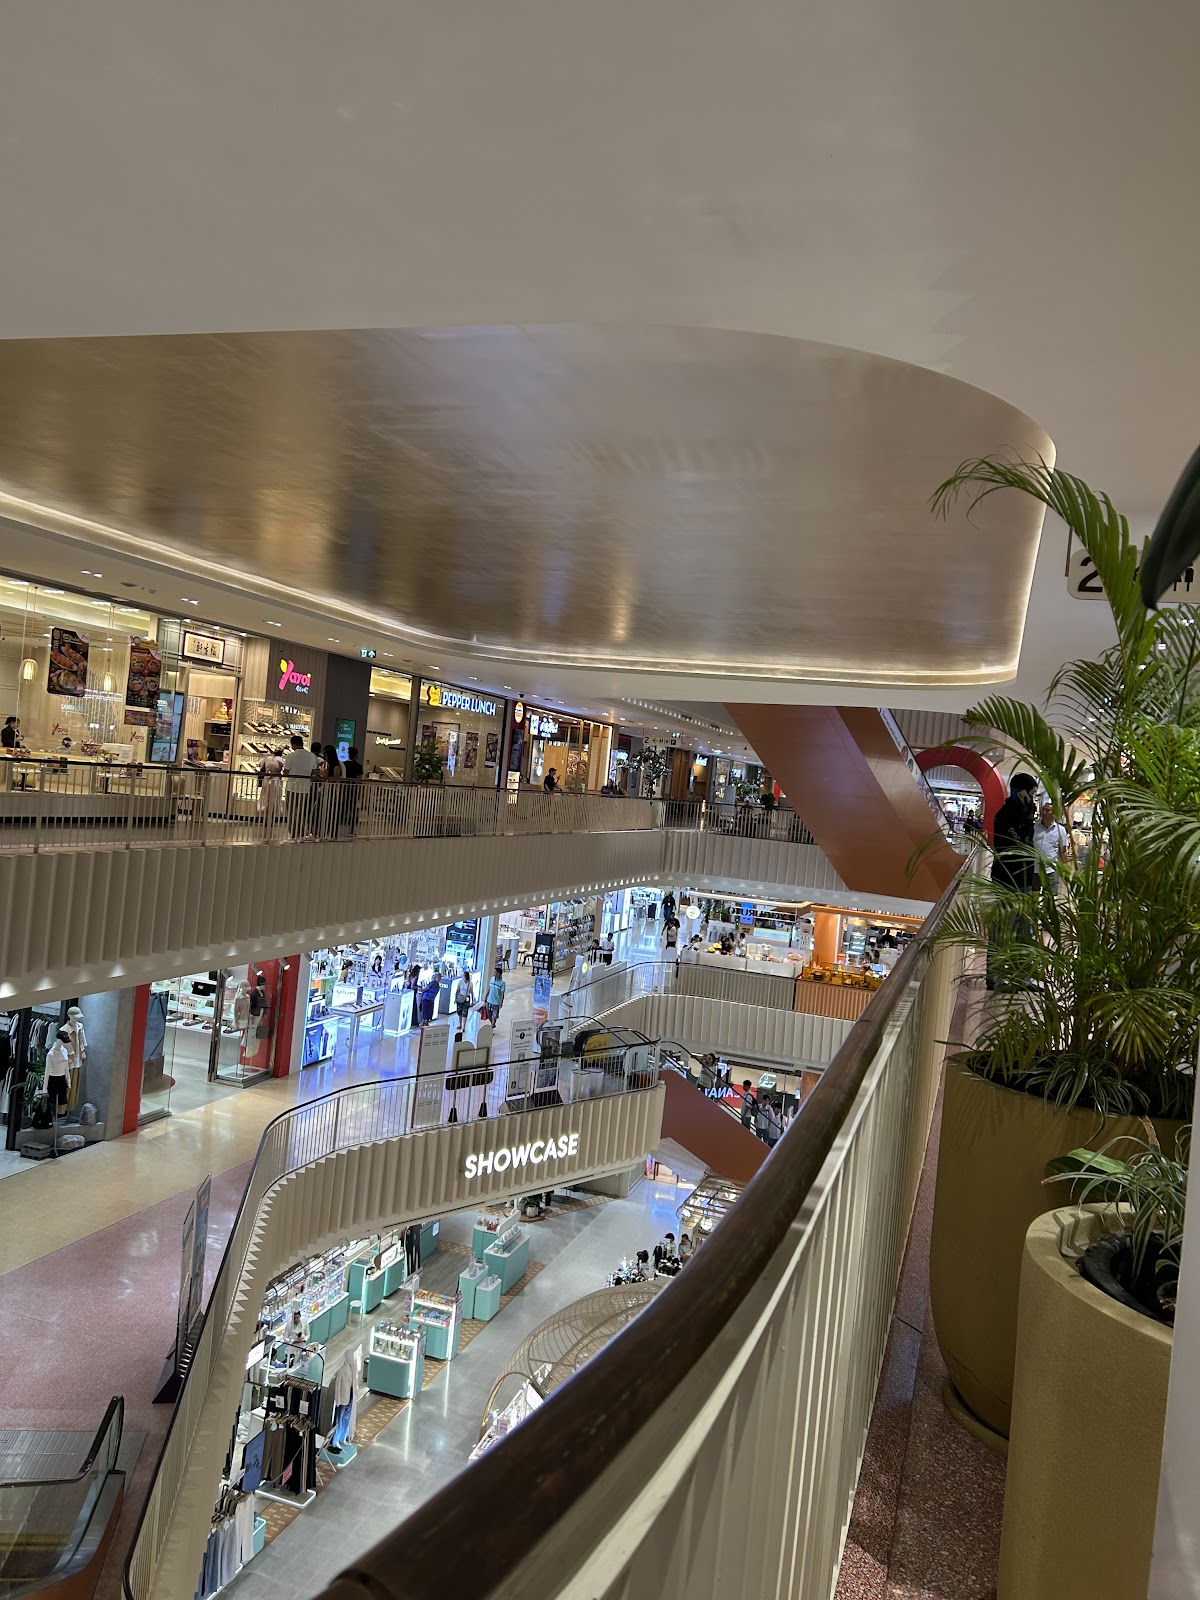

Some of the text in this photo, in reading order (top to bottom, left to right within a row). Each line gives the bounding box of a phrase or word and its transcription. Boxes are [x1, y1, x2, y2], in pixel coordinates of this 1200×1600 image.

[1077, 555, 1104, 593] 2
[442, 691, 471, 711] PEPPER
[470, 698, 497, 716] LUNCH
[464, 1133, 580, 1179] SHOWCASE
